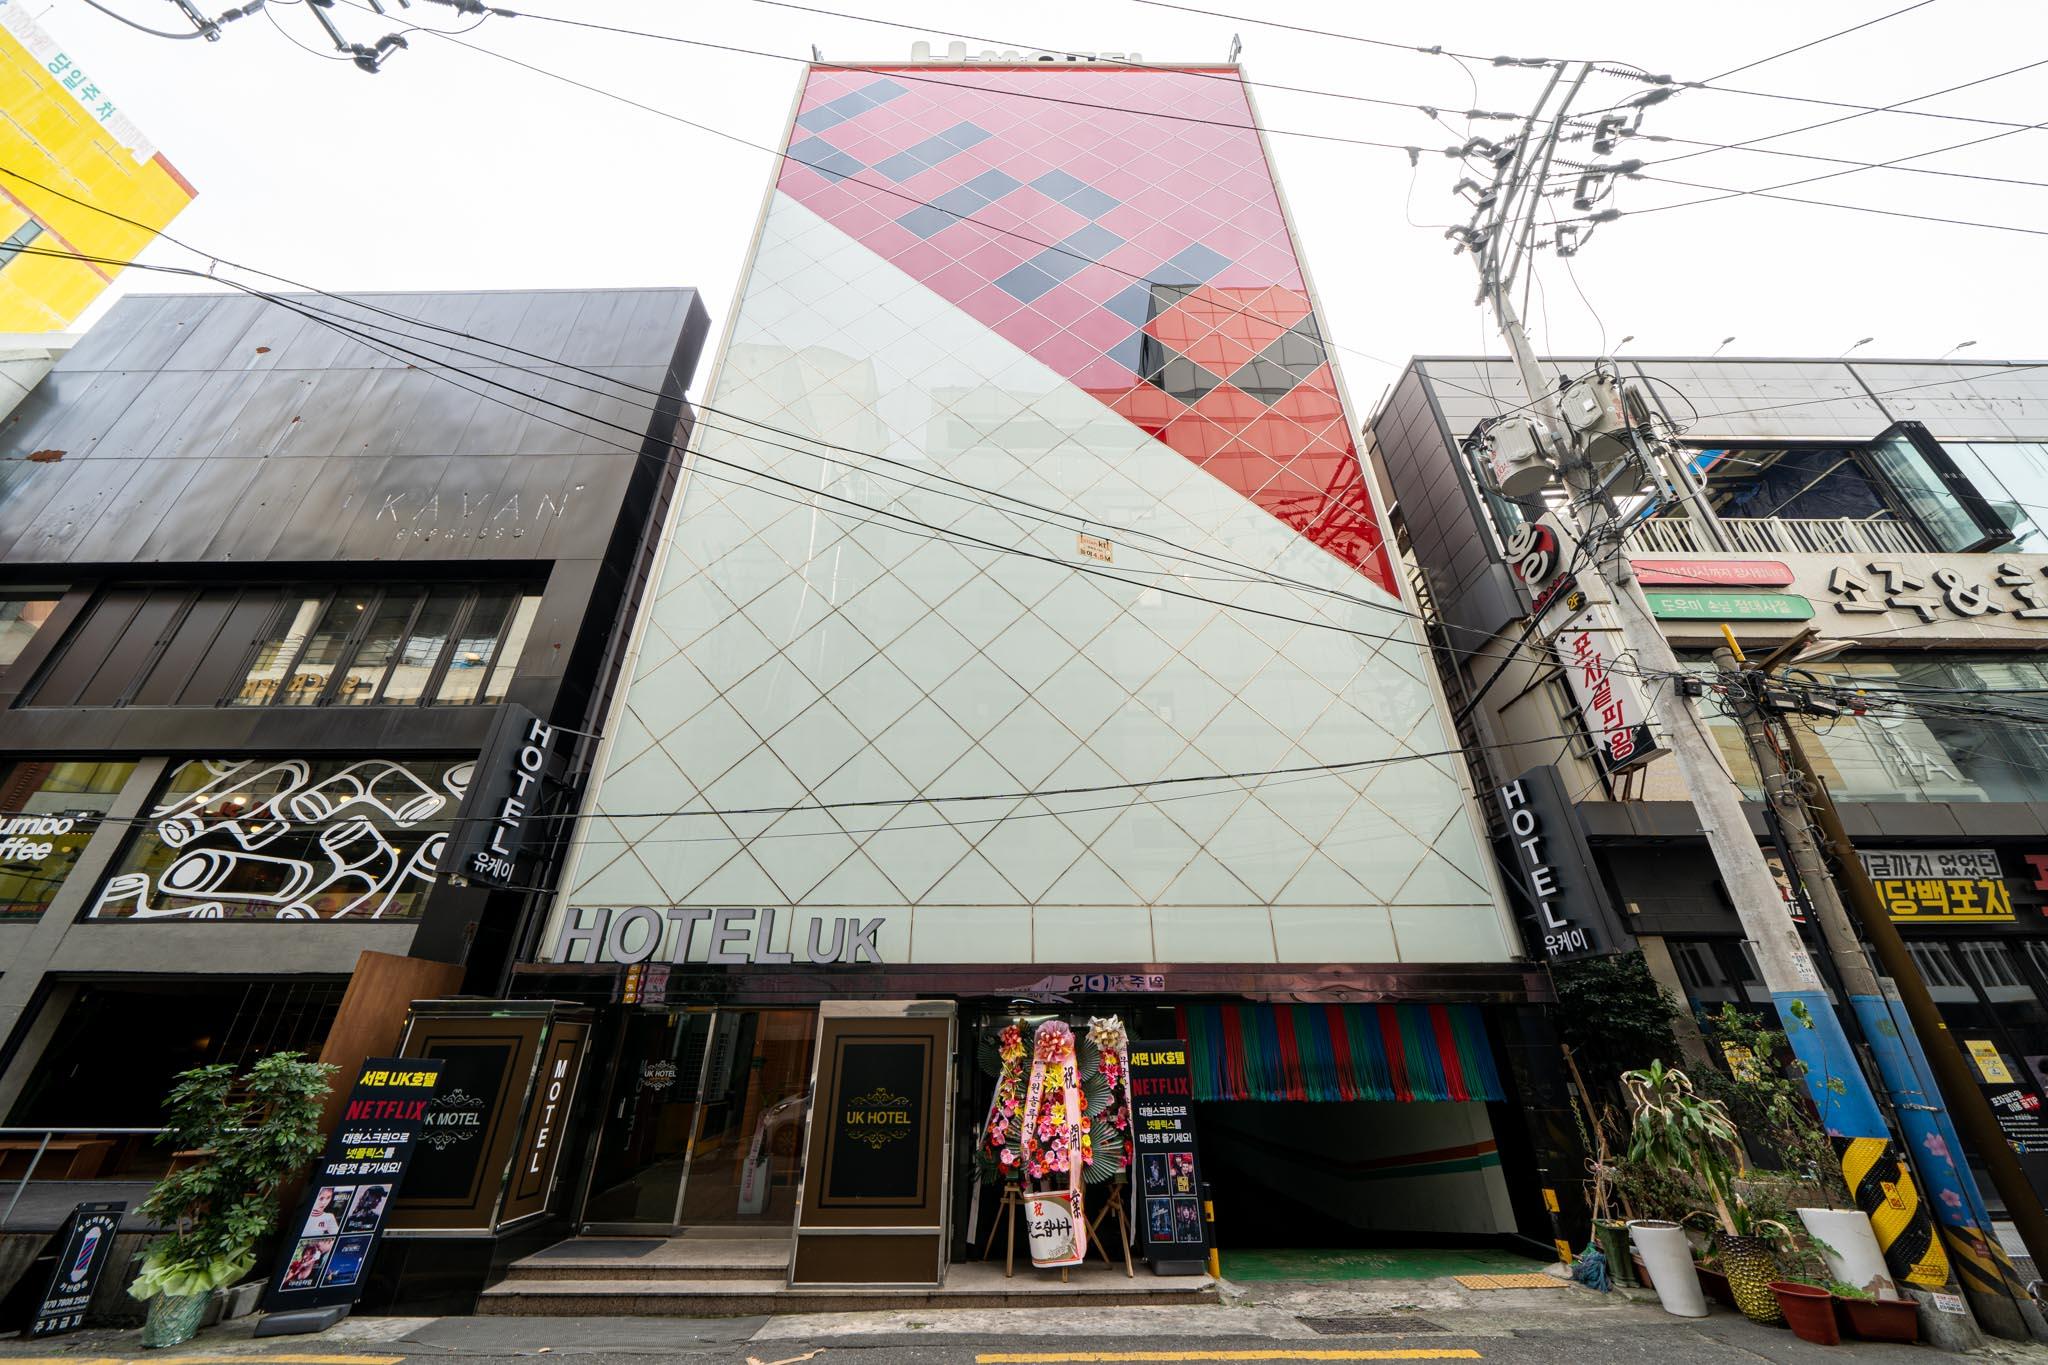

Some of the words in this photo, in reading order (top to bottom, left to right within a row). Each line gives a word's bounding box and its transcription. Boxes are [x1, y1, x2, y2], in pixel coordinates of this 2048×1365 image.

[376, 492, 569, 521] KAVAN
[1567, 593, 1580, 611] 2F
[1661, 599, 1705, 612] 도우미
[1707, 600, 1732, 613] 손님
[491, 718, 552, 856] HOTEL
[1501, 779, 1567, 929] HOTEL
[474, 852, 515, 882] 유케이
[1938, 853, 2001, 877] 없었던
[553, 905, 795, 965] HOTEL
[806, 916, 887, 965] UK
[1544, 928, 1588, 956] 유케이
[1131, 1052, 1149, 1066] 서면
[1150, 1051, 1186, 1066] UK호텔
[360, 1070, 389, 1086] 서면
[388, 1071, 438, 1087] UK호텔
[644, 1070, 654, 1078] UK
[655, 1070, 677, 1078] HOTEL
[1132, 1077, 1189, 1097] NETFLIX
[345, 1100, 427, 1121] NETFLIX
[436, 1112, 481, 1126] MOTEL
[530, 1060, 568, 1173] MOTEL
[846, 1111, 865, 1125] UK
[867, 1111, 912, 1125] HOTEL
[1139, 1106, 1188, 1117] 대형스크린으로
[1147, 1119, 1182, 1130] 넷플릭스를
[341, 1132, 410, 1144] 대형스크린으로
[345, 1147, 396, 1160] 넷플릭스를
[1033, 1201, 1044, 1217] 祝
